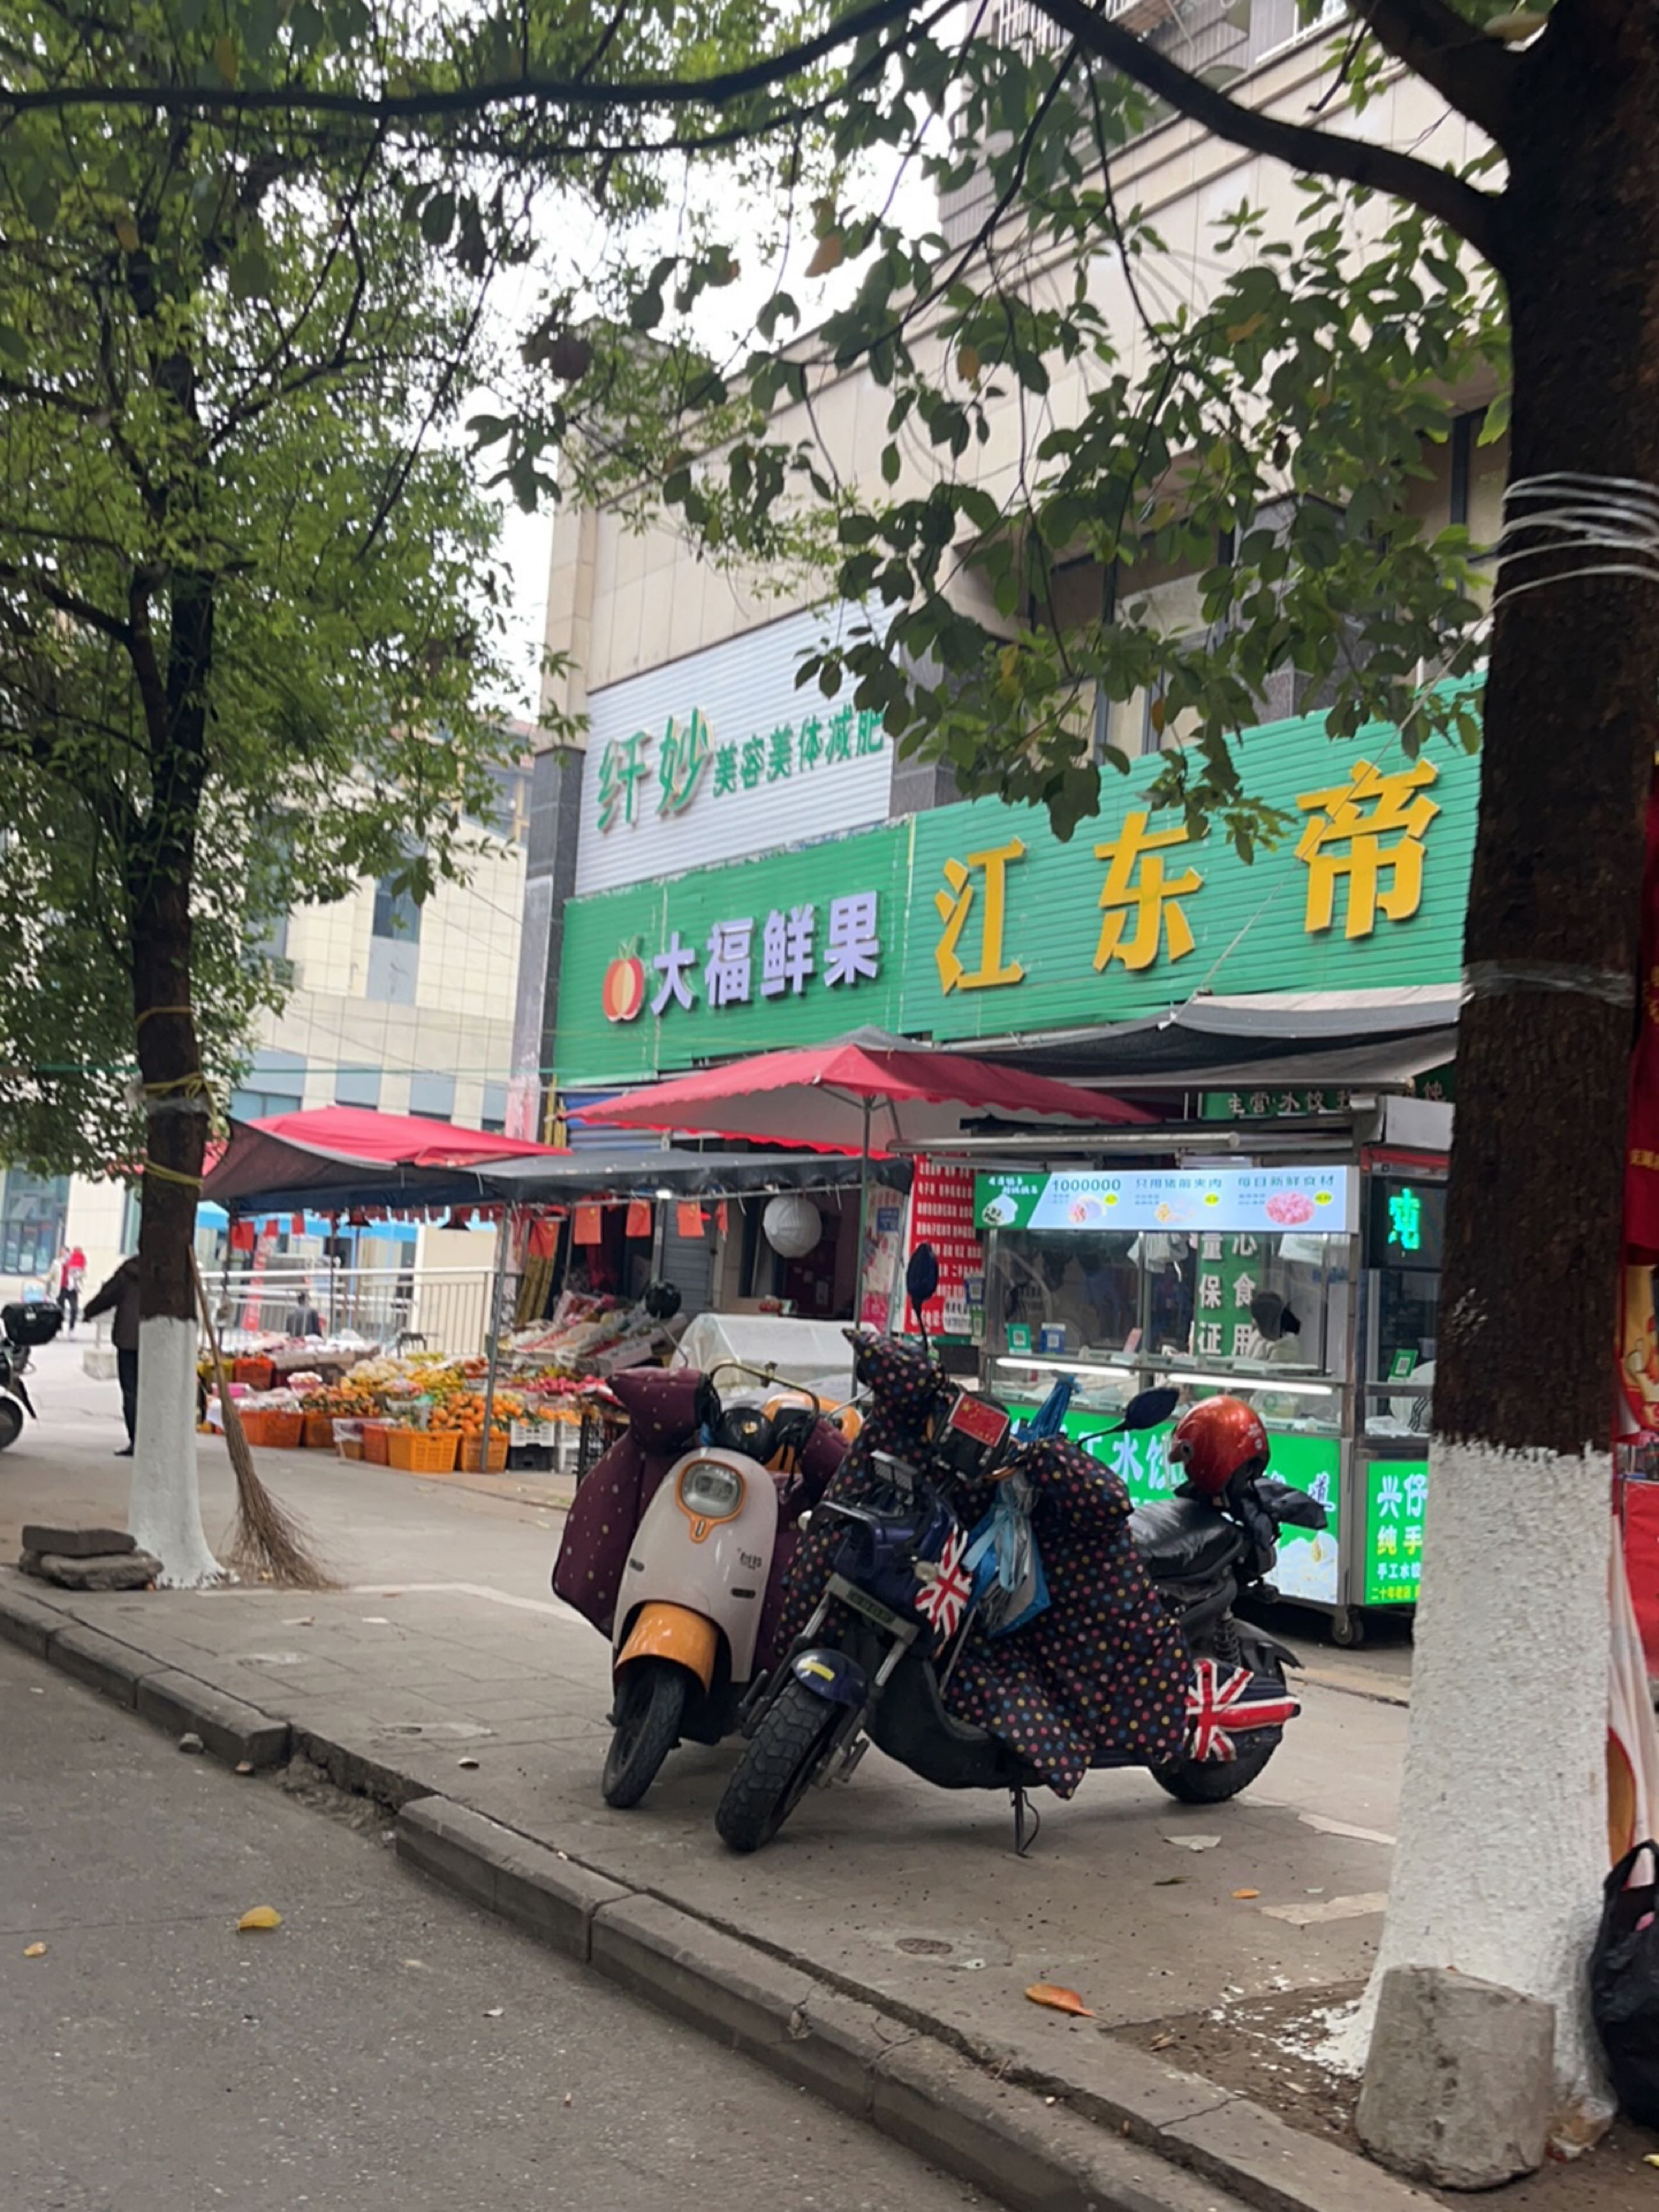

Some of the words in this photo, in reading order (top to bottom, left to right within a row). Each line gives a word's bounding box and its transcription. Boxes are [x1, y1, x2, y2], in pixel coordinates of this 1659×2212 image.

[597, 707, 714, 831] 纤妙
[713, 703, 884, 798] 美容美体减肥
[934, 758, 1440, 995] 江东帝
[651, 890, 878, 1015] 大福鲜果
